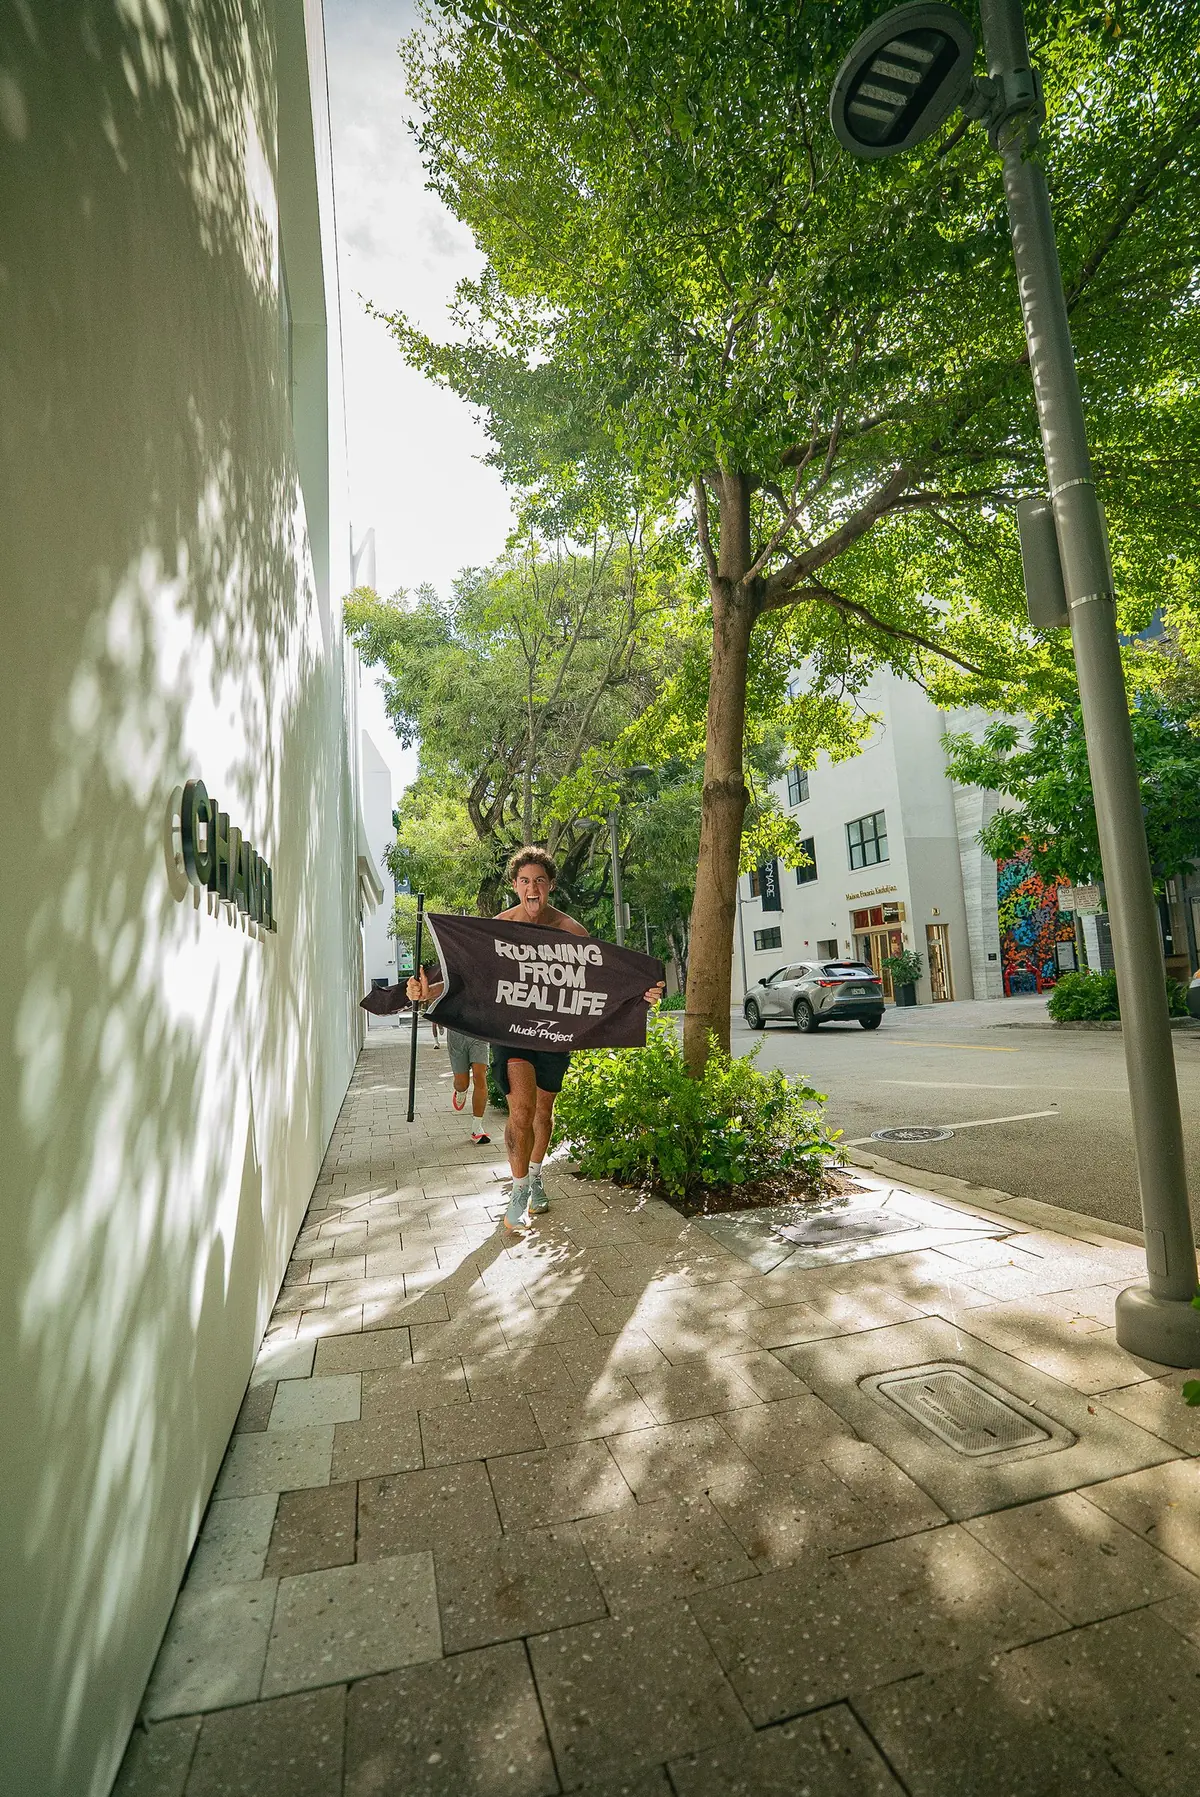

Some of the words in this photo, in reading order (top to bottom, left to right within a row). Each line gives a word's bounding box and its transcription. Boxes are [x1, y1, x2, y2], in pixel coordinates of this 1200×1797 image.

[181, 779, 277, 934] CHANEL
[494, 939, 603, 967] RUNNING
[518, 961, 587, 989] FROM
[495, 980, 554, 1012] REAL
[556, 989, 608, 1016] LIFE
[539, 1029, 574, 1043] Project
